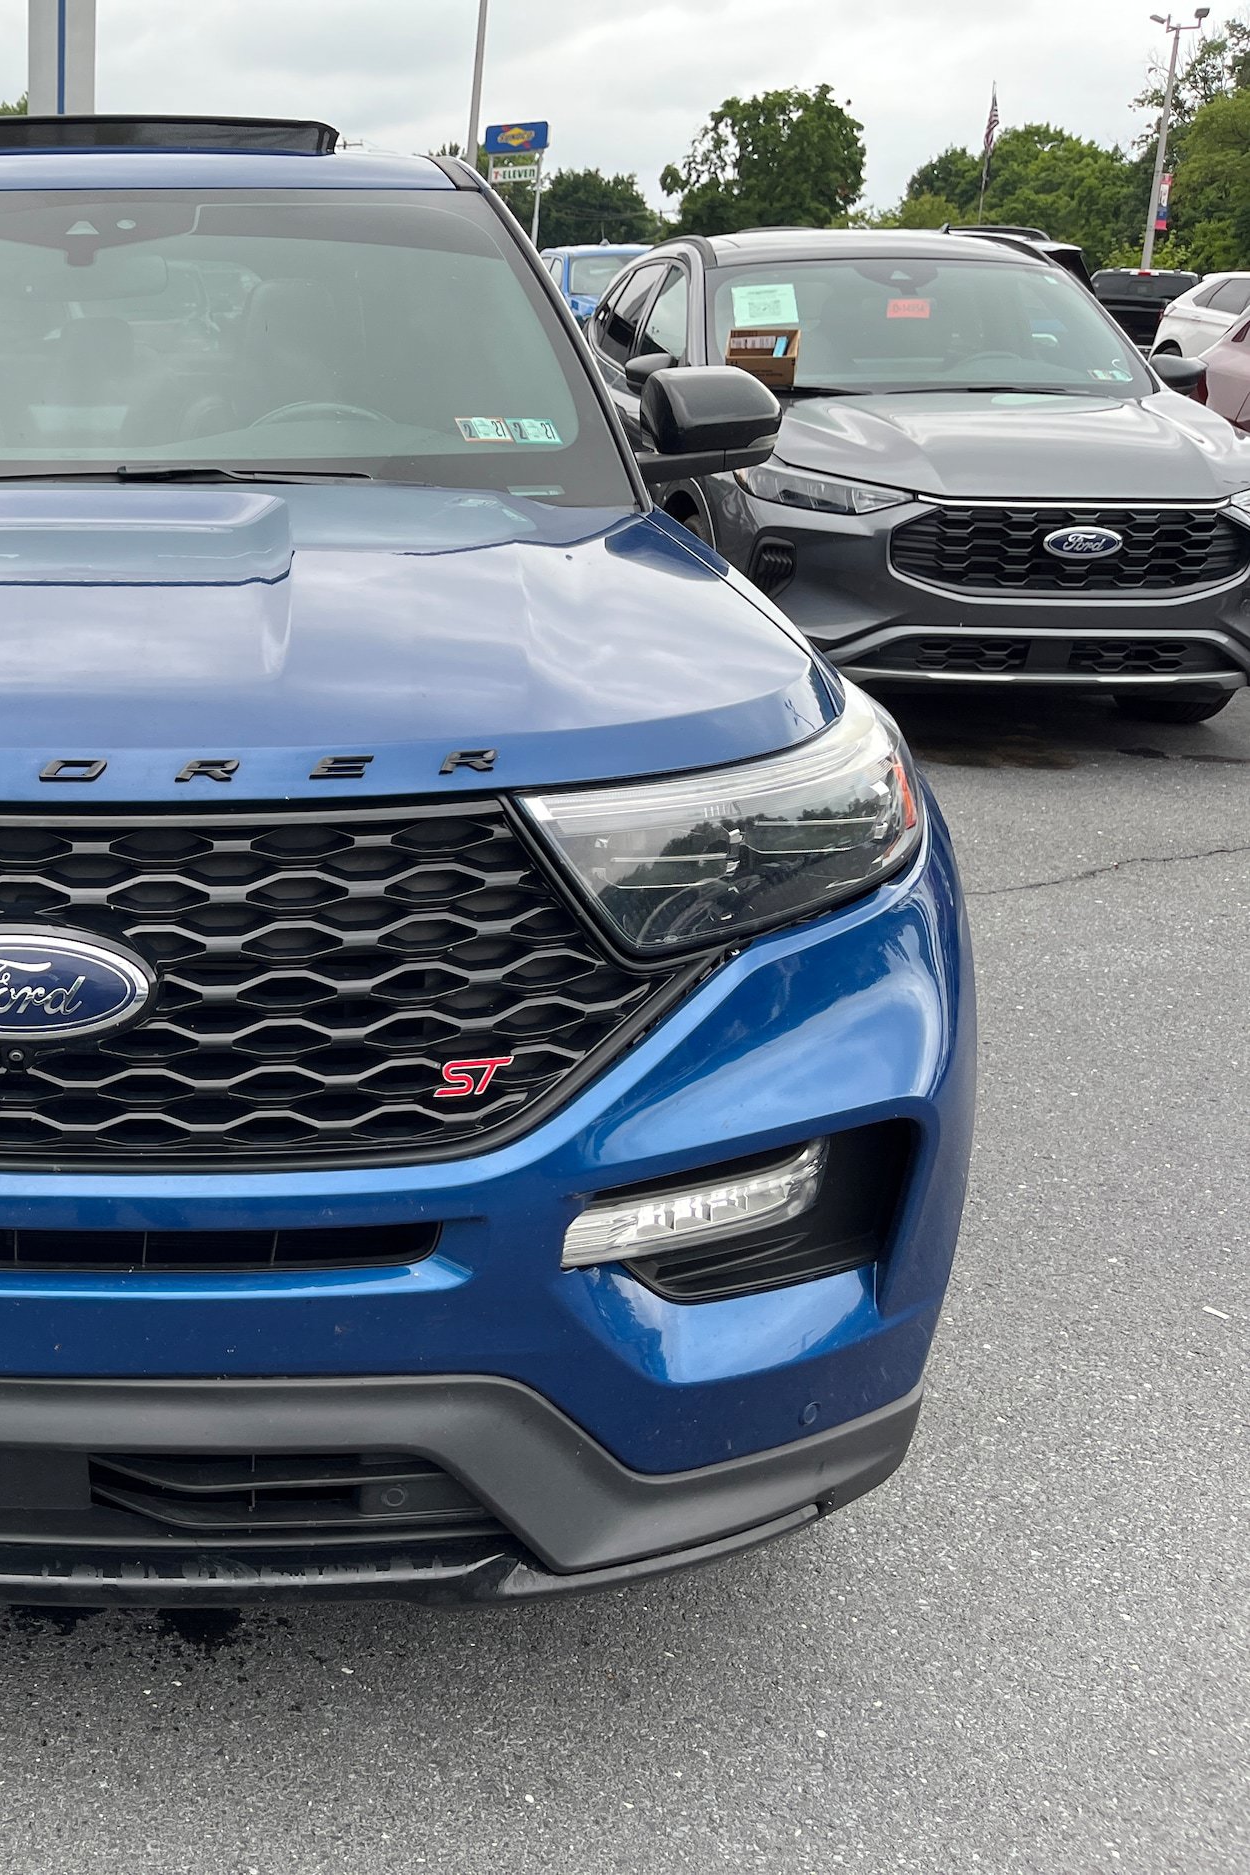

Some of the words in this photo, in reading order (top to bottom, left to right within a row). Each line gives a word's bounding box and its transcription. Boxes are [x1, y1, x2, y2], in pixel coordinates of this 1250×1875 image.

[497, 130, 535, 143] SUNOCO
[463, 423, 476, 438] 2
[491, 420, 507, 438] 27
[513, 422, 528, 440] 2
[540, 422, 556, 440] 27
[1062, 533, 1106, 552] Ford
[433, 1056, 514, 1097] ST
